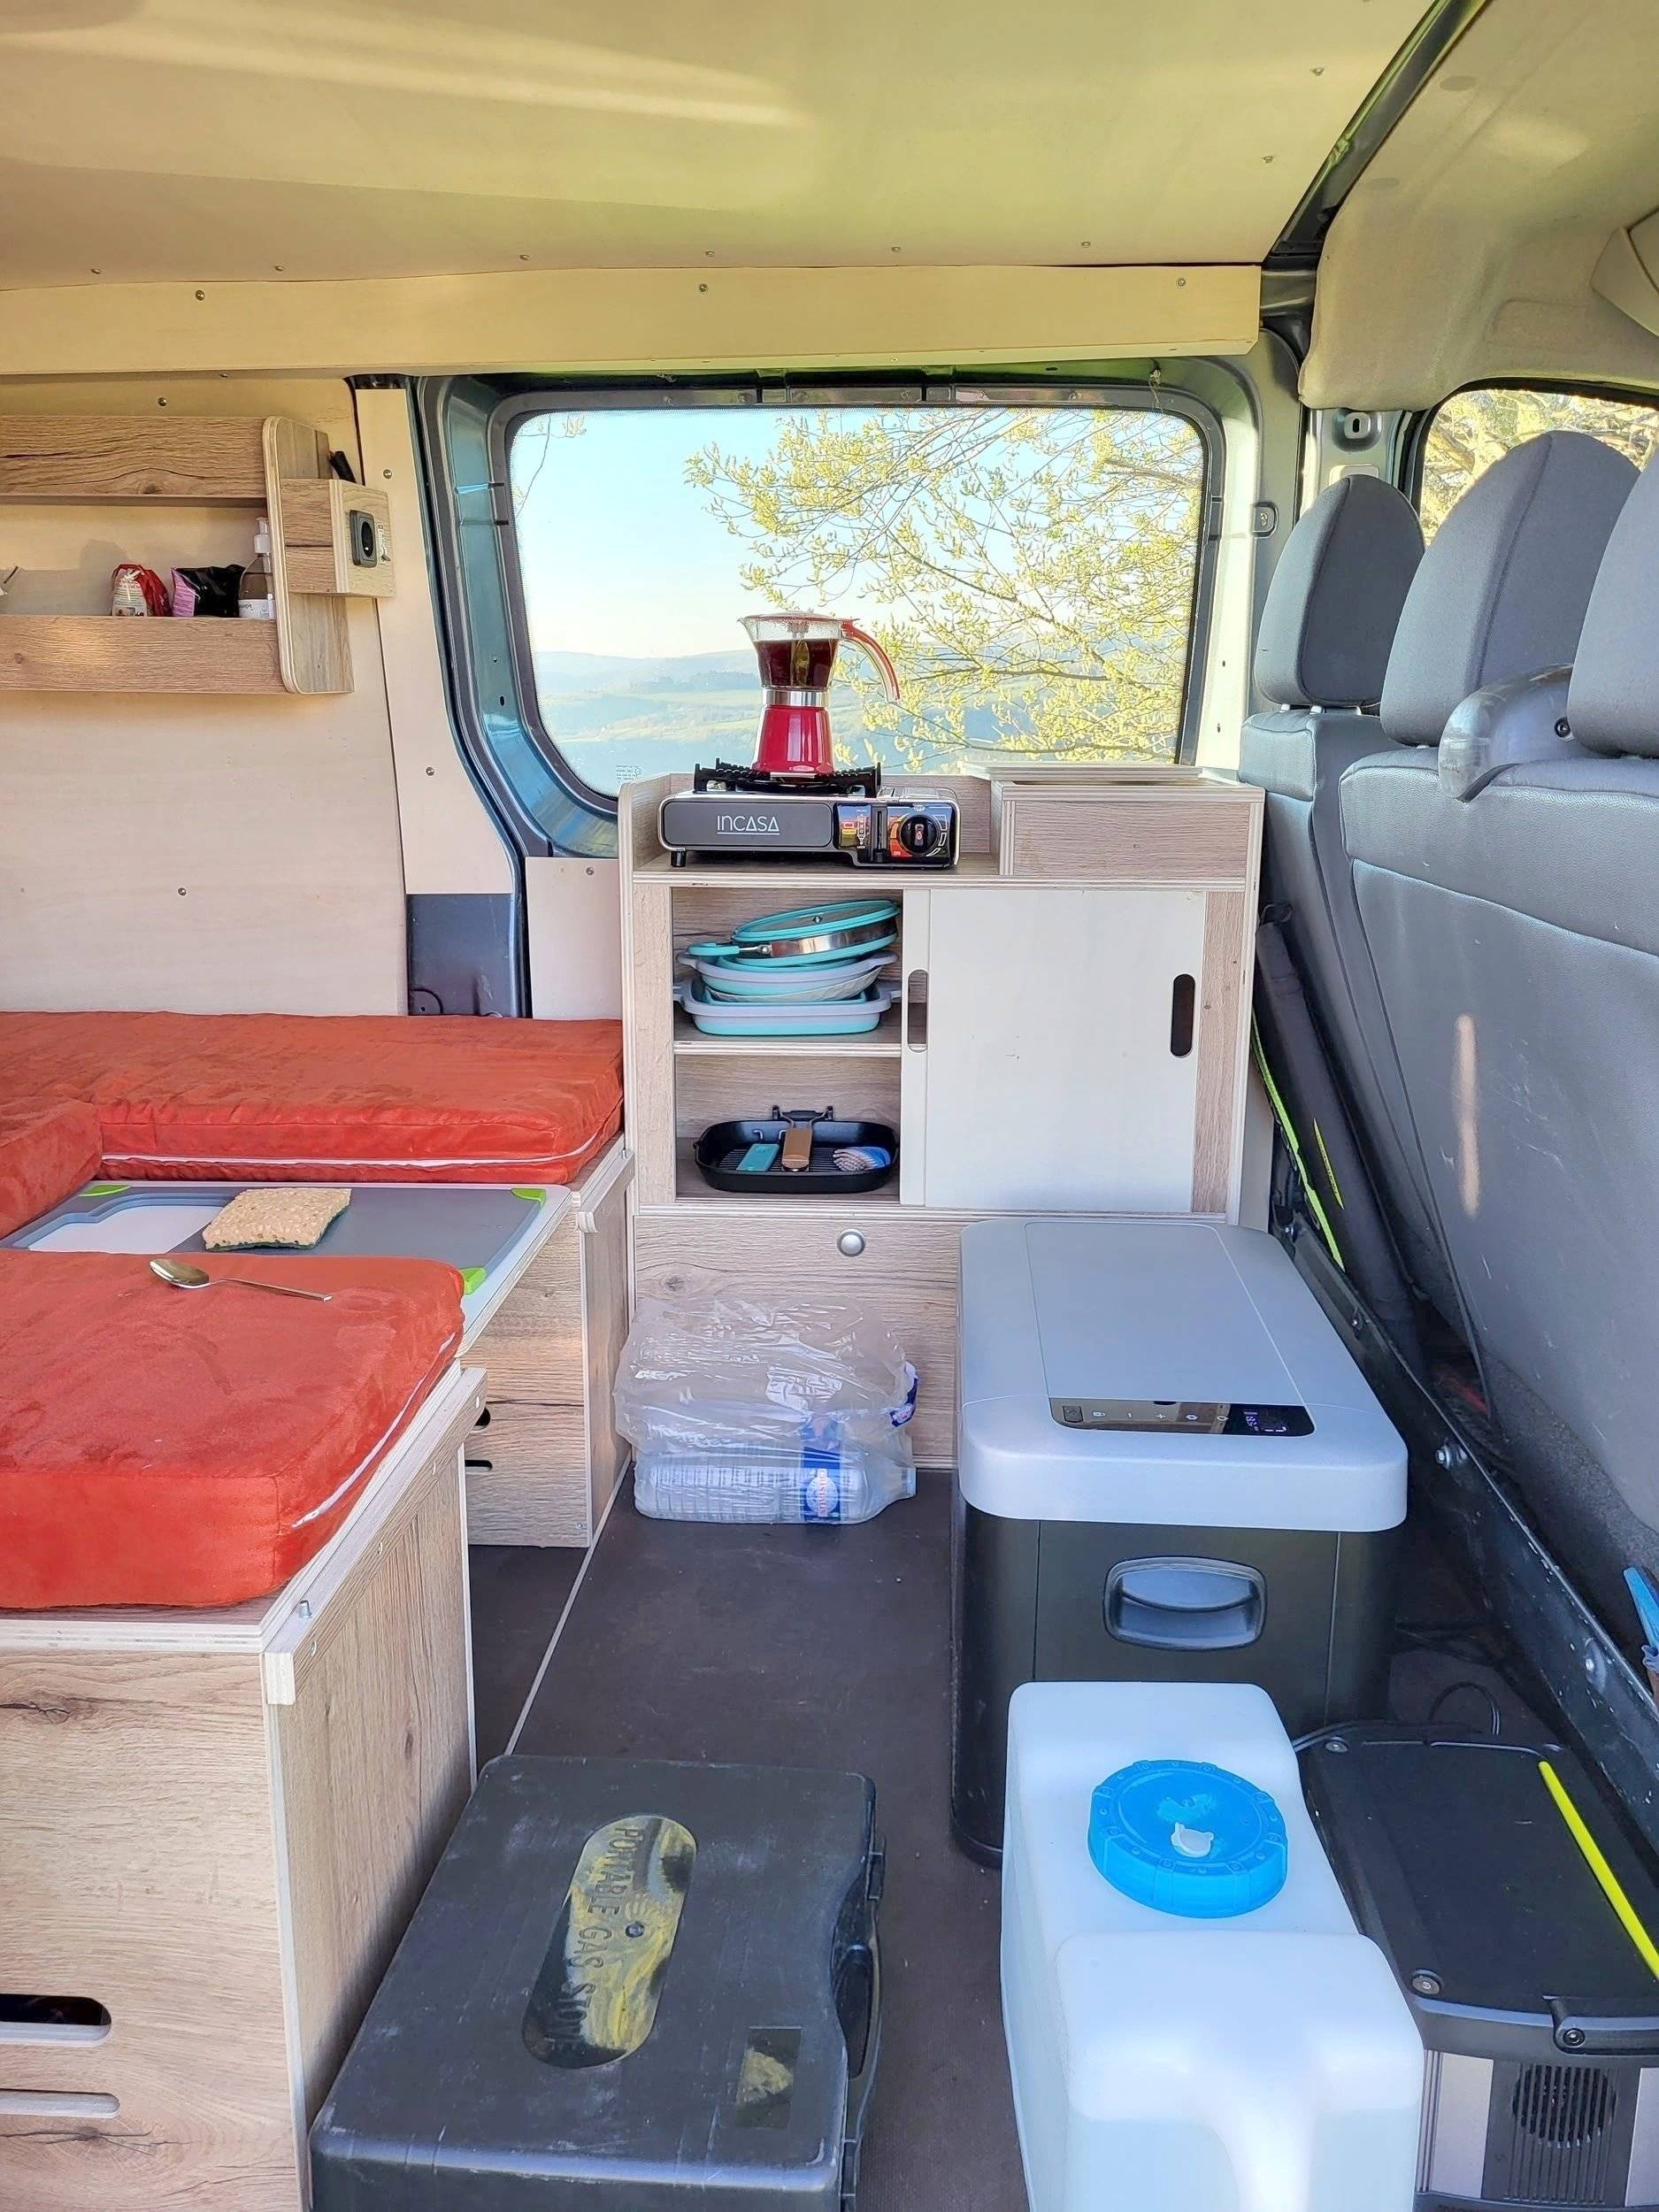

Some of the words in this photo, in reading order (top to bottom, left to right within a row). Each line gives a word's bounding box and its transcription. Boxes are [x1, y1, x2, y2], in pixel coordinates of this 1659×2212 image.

[717, 815, 780, 832] INCASA
[588, 1827, 644, 1915] PORTABLE
[568, 1926, 612, 1968] GAS
